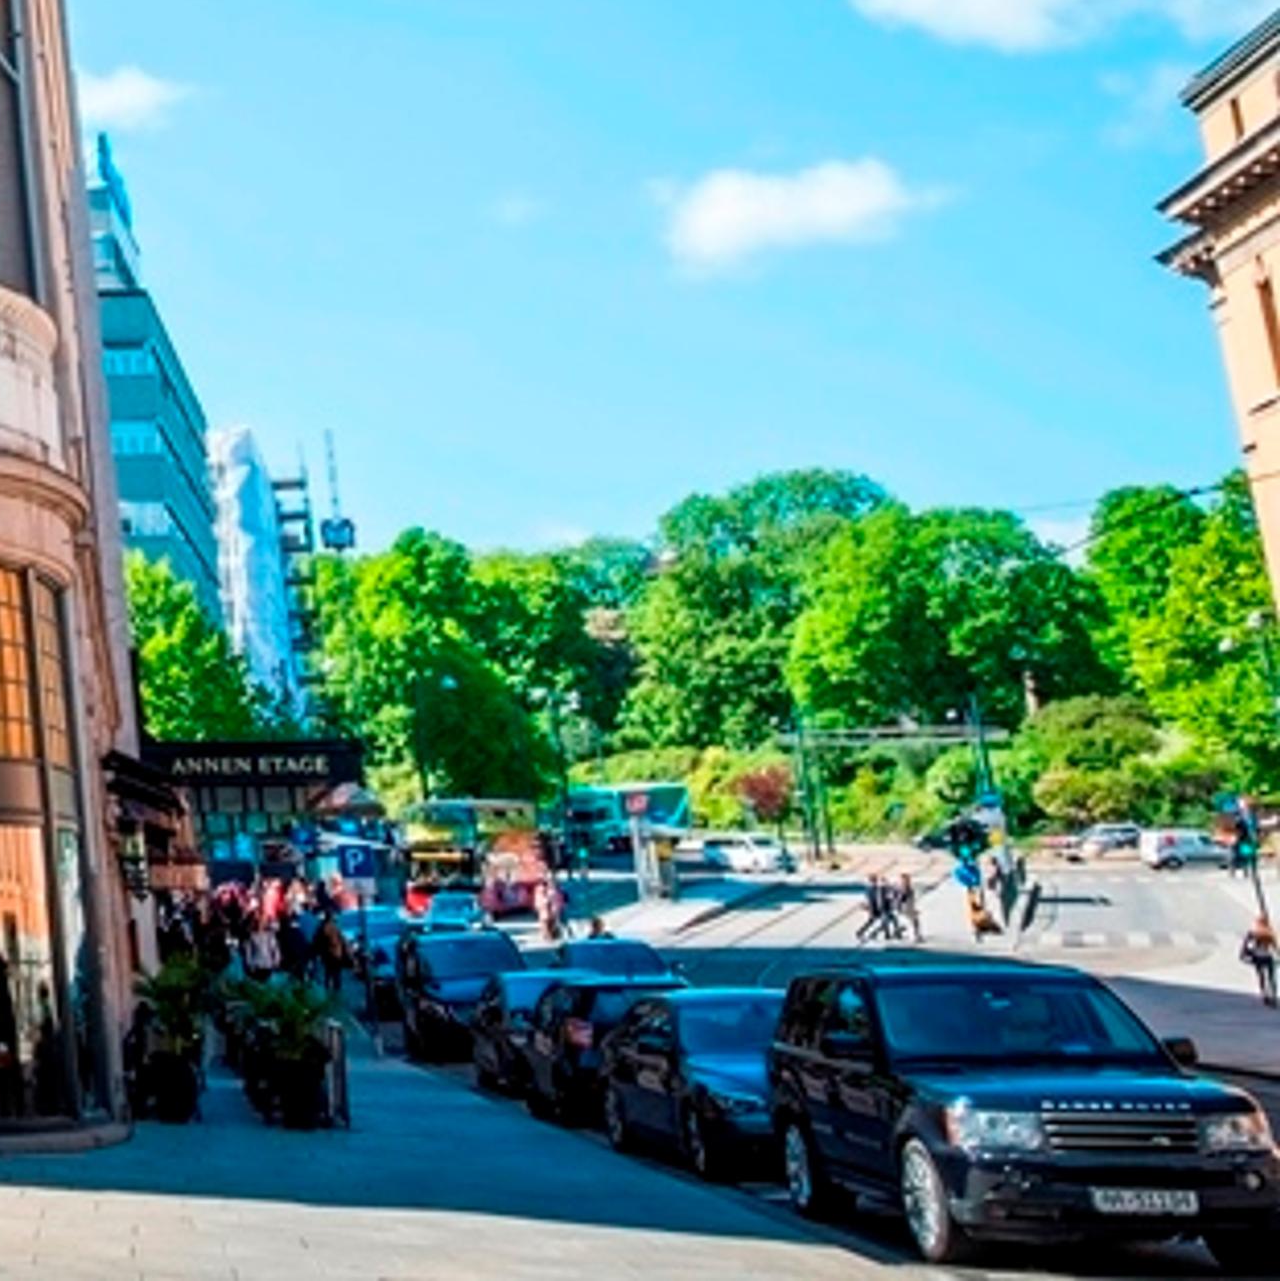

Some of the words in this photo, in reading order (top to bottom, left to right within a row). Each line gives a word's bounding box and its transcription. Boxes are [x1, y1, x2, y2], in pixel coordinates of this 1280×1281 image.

[172, 756, 252, 776] ANNEN
[257, 755, 330, 775] ETAGE
[345, 848, 364, 874] P
